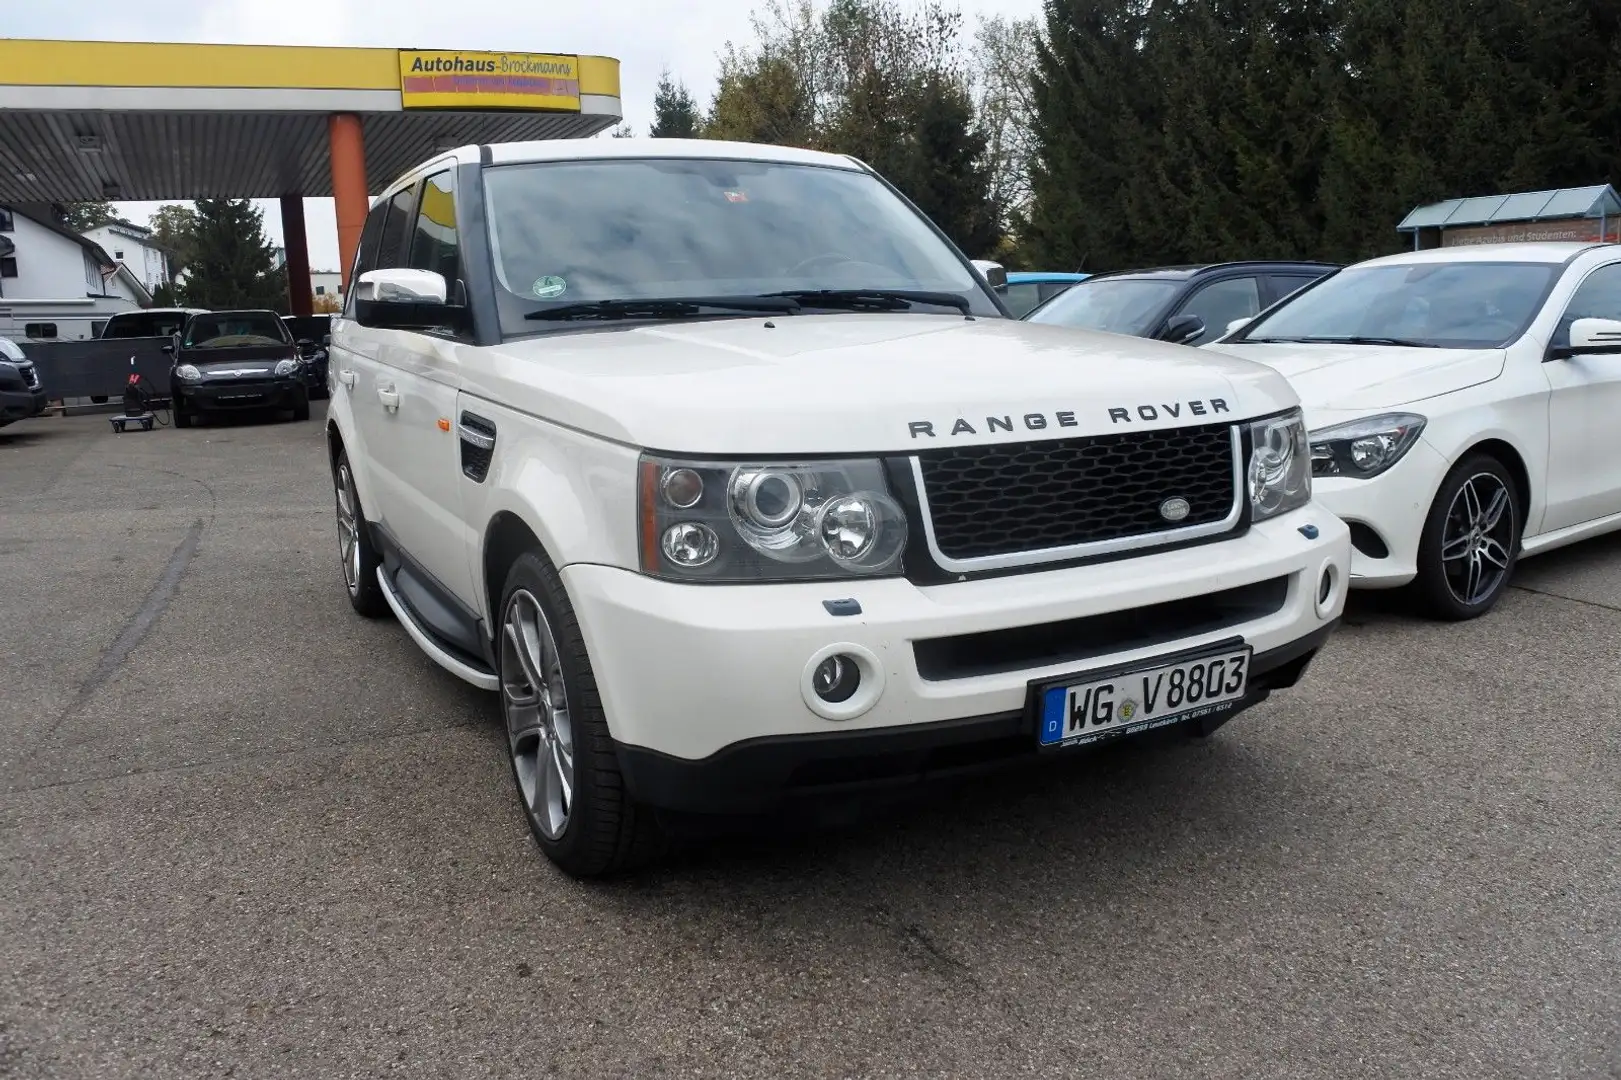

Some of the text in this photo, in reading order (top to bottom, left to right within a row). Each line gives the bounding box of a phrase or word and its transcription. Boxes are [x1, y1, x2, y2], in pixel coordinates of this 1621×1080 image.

[411, 56, 496, 72] Autohaus
[1507, 232, 1525, 243] und
[907, 398, 1230, 439] RANGE ROVER
[1069, 684, 1114, 732] WG
[1048, 720, 1057, 732] D
